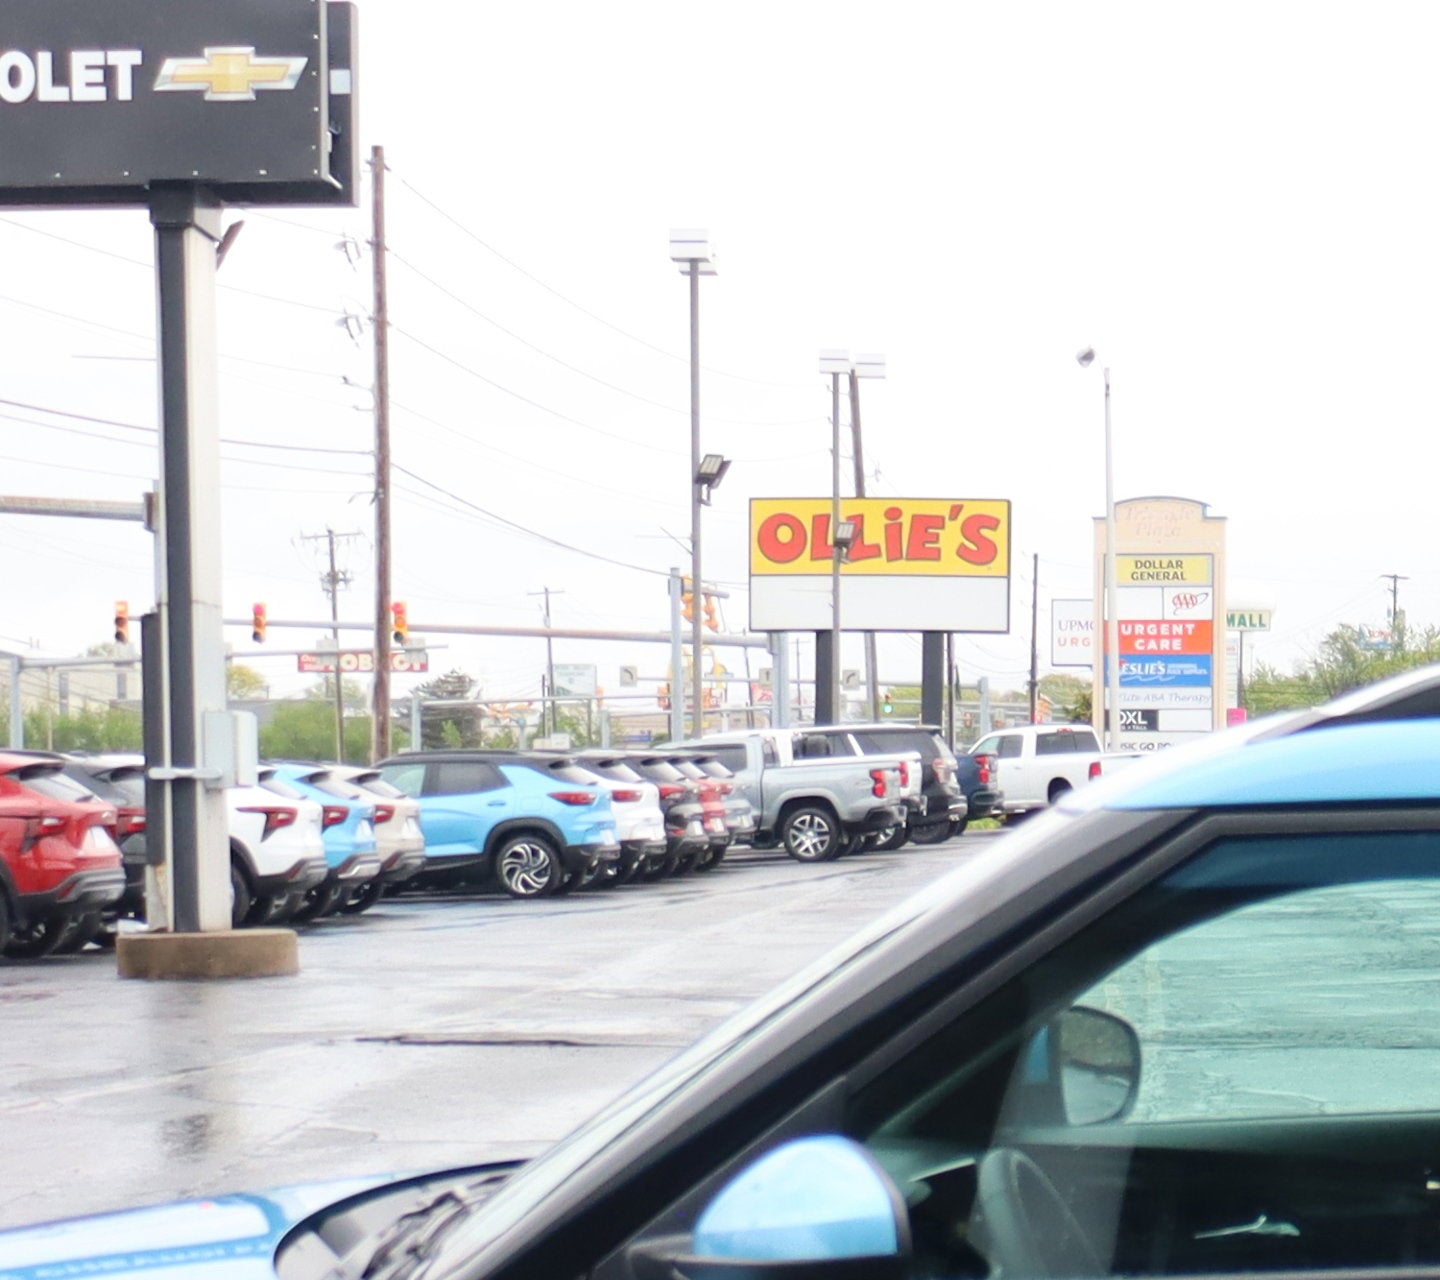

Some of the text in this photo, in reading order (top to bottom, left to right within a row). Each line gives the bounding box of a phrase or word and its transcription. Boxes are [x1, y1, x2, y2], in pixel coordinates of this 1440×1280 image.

[1134, 559, 1184, 570] DOLLAR
[1130, 571, 1187, 581] GENERAL
[1226, 613, 1267, 628] MALL
[1121, 623, 1195, 636] URGENT
[1135, 638, 1182, 651] CARE
[1113, 661, 1166, 675] ESLIE'S
